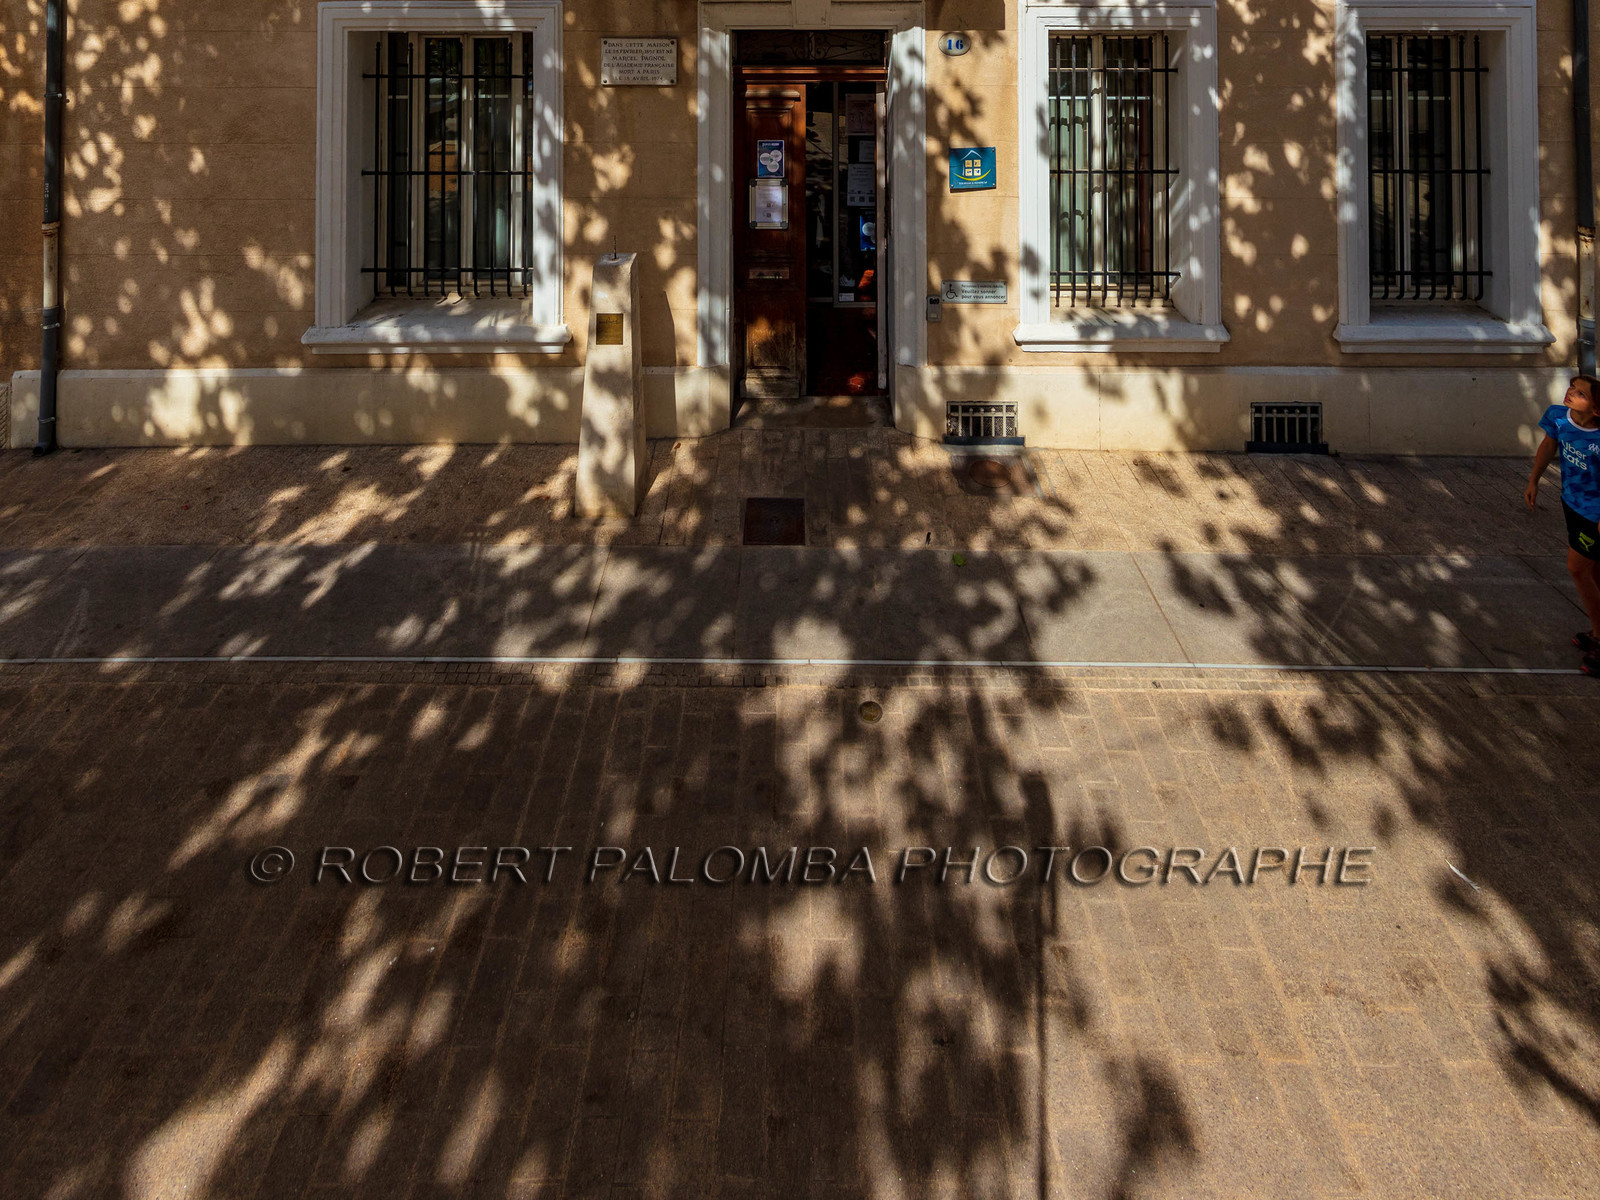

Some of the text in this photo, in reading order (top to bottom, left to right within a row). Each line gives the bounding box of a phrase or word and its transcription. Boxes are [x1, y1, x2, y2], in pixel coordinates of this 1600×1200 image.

[947, 39, 964, 50] 16
[1561, 439, 1587, 460] Uber
[1562, 448, 1588, 471] Eats
